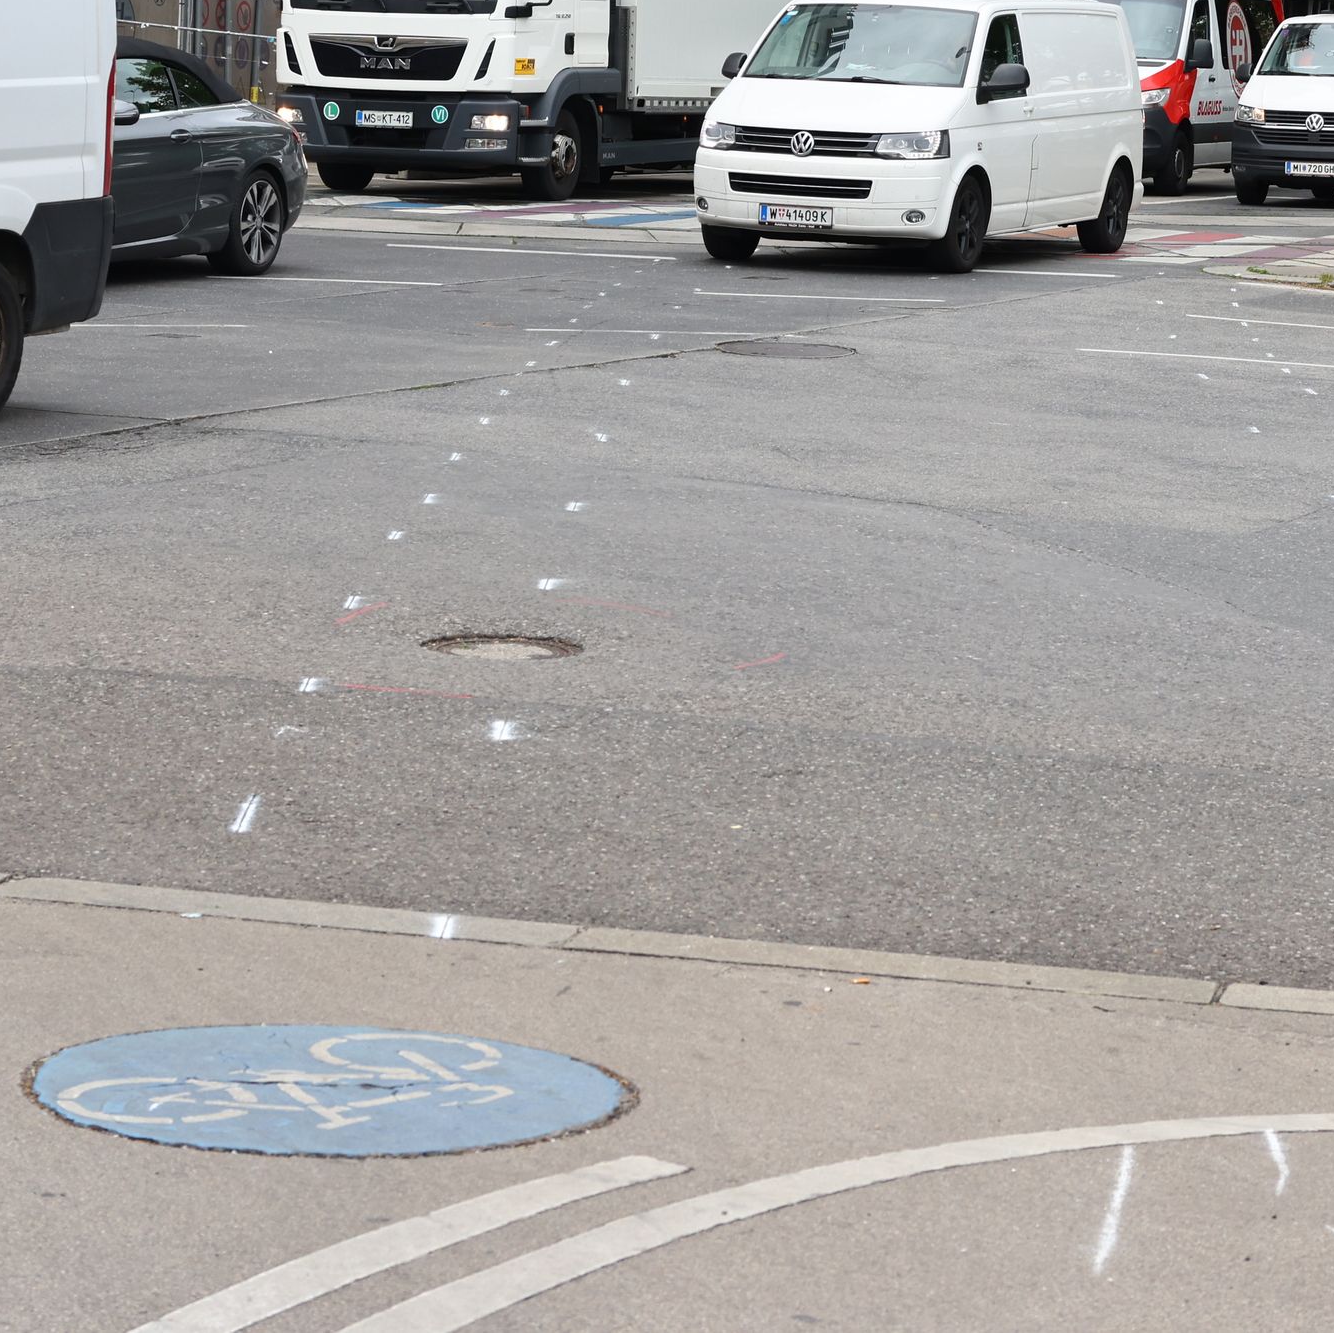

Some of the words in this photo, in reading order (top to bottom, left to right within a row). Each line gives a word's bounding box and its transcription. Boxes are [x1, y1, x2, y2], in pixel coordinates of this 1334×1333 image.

[360, 57, 411, 70] MAN
[328, 105, 335, 118] L
[1197, 100, 1223, 116] BLAGUSS
[363, 114, 376, 123] MS
[382, 115, 410, 125] KT-412
[435, 109, 445, 121] VI
[1293, 164, 1302, 172] MI
[1308, 165, 1322, 173] 720
[1324, 166, 1334, 174] GH
[770, 208, 778, 219] W
